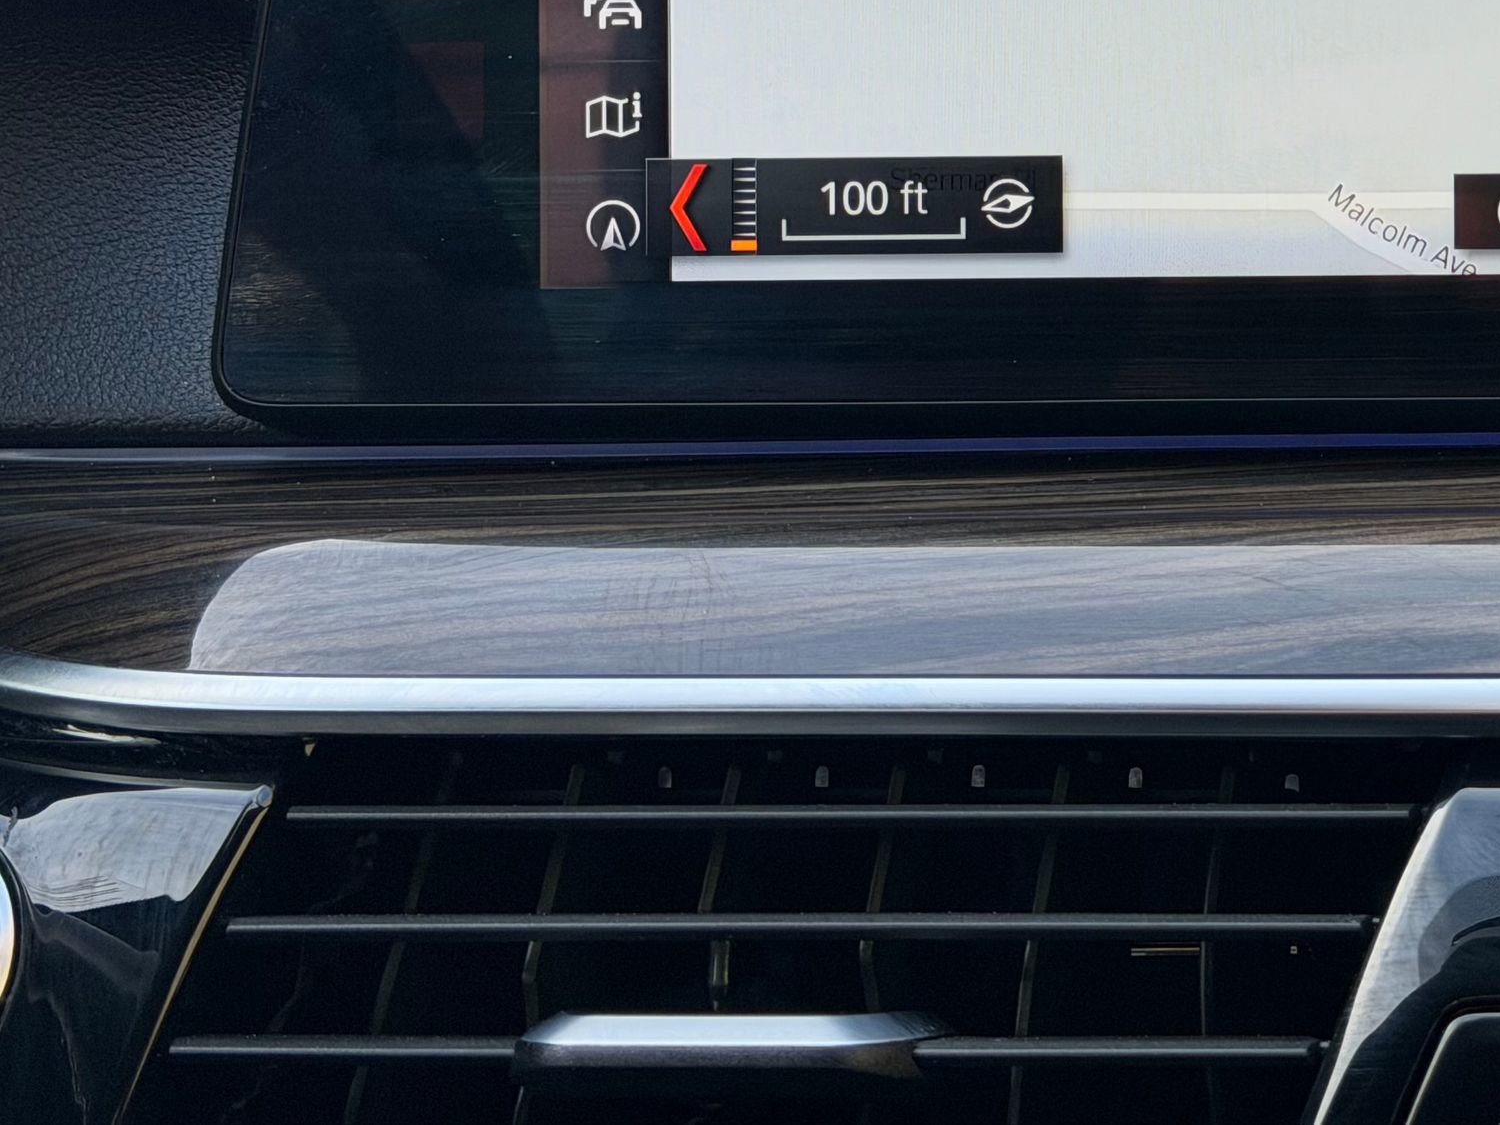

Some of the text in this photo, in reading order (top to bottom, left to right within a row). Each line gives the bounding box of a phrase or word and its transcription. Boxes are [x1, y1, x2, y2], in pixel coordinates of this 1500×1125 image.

[819, 179, 929, 216] 100 ft
[1327, 183, 1478, 276] Malcolm Ave
